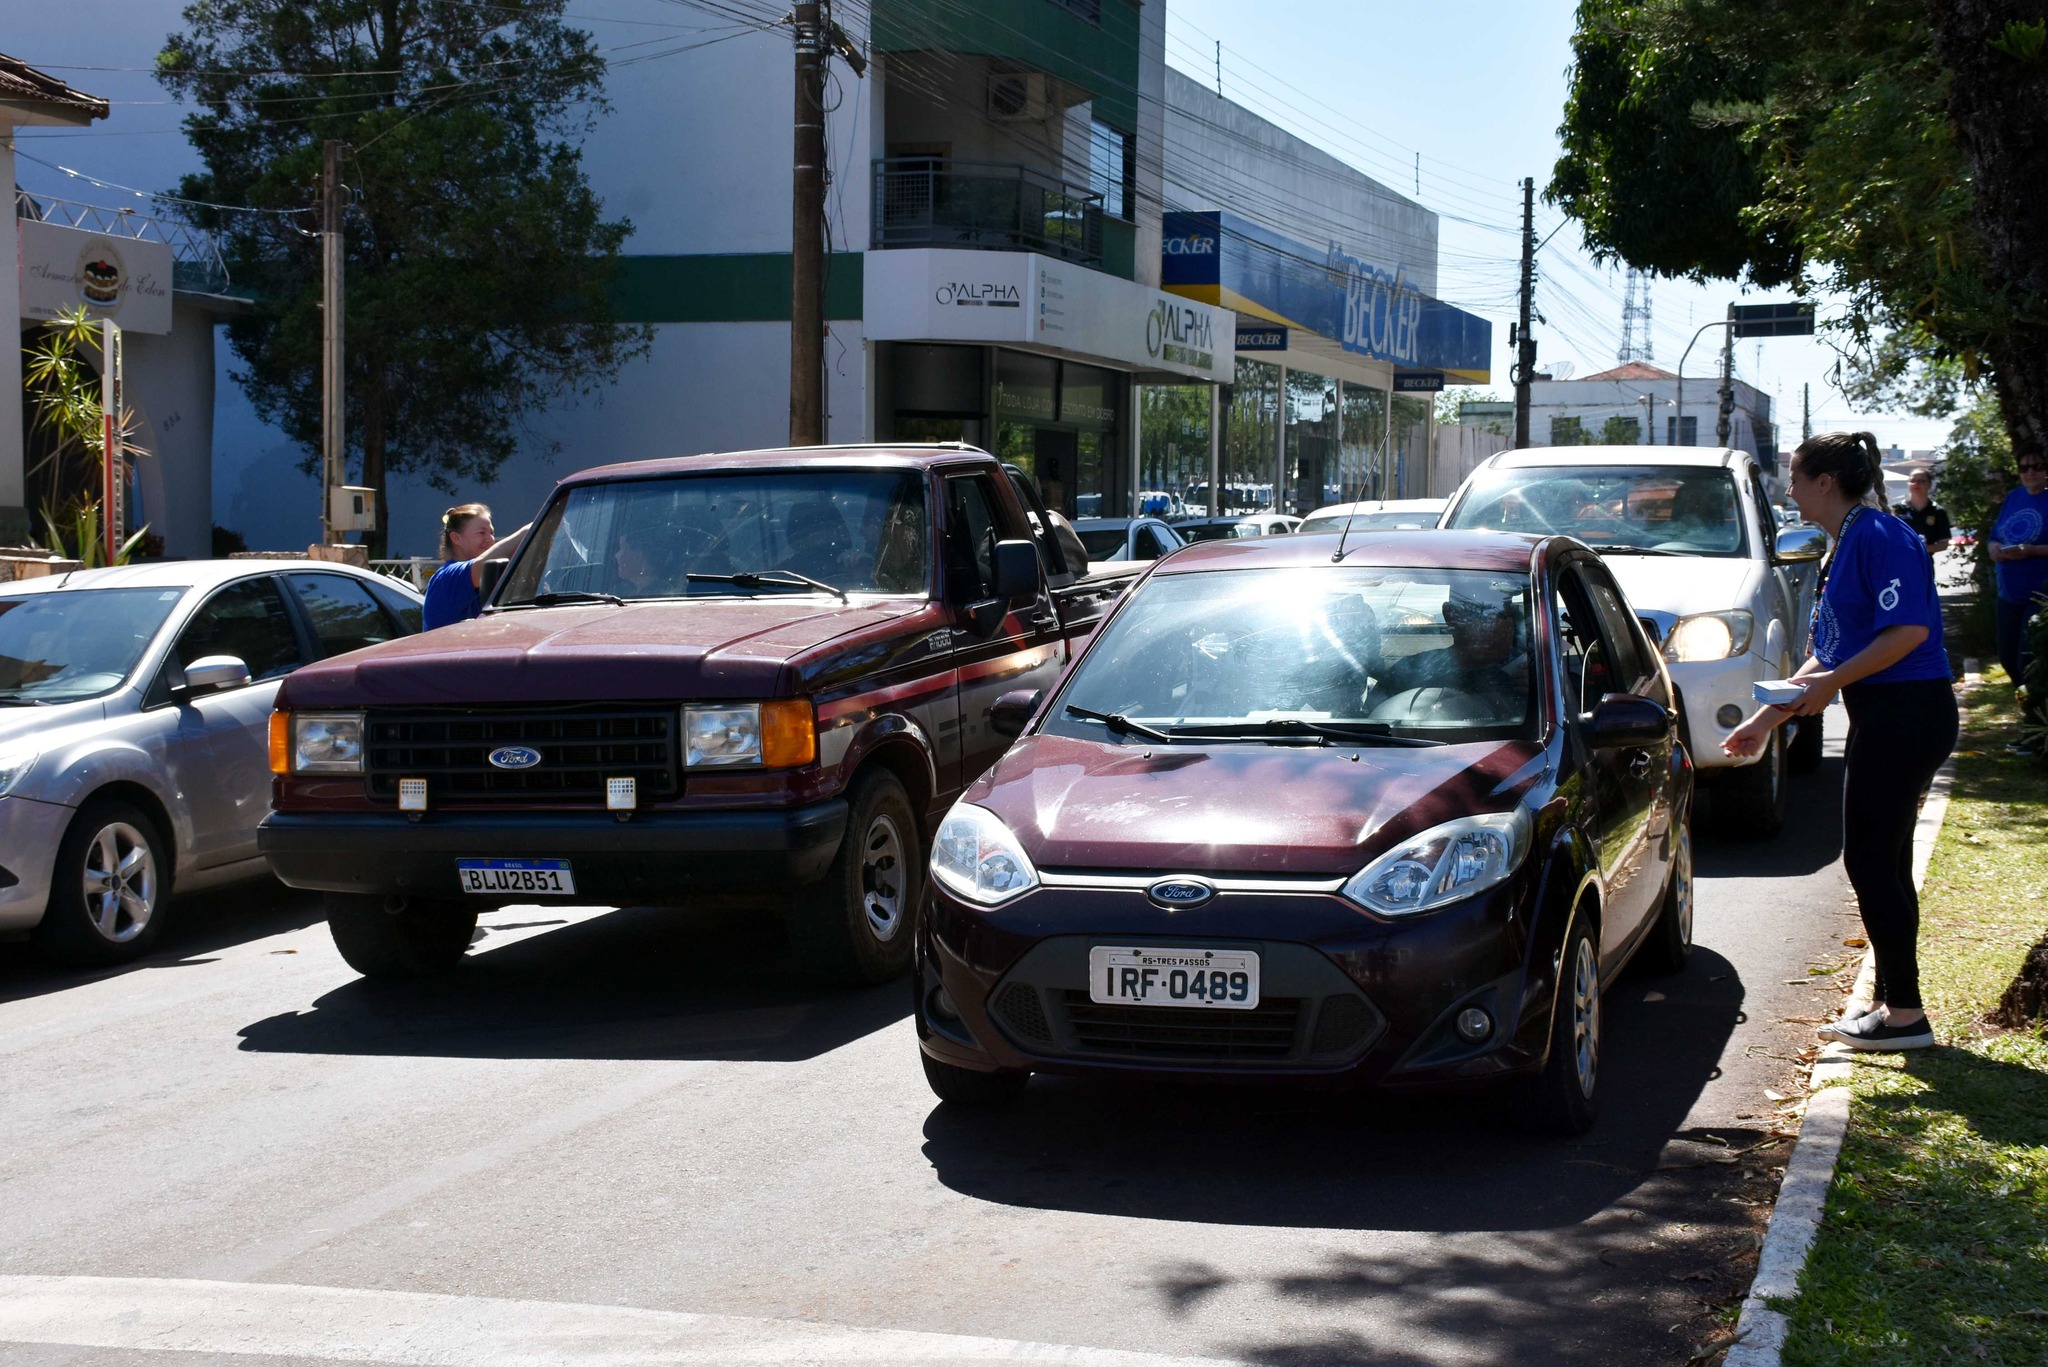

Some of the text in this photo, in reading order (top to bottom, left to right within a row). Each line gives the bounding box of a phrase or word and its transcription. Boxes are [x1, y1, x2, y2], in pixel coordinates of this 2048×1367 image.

[1163, 236, 1215, 255] ECKER
[957, 283, 1020, 300] ALPHA
[1344, 265, 1421, 363] BECKER
[1164, 303, 1213, 350] ALPHA
[1237, 333, 1281, 345] BECKER
[1403, 377, 1440, 388] BECKER
[1023, 396, 1040, 410] LOJA
[500, 750, 529, 765] Ford
[468, 870, 563, 891] BLU2B51
[1164, 885, 1195, 898] Ford
[1178, 958, 1211, 967] PASSOS
